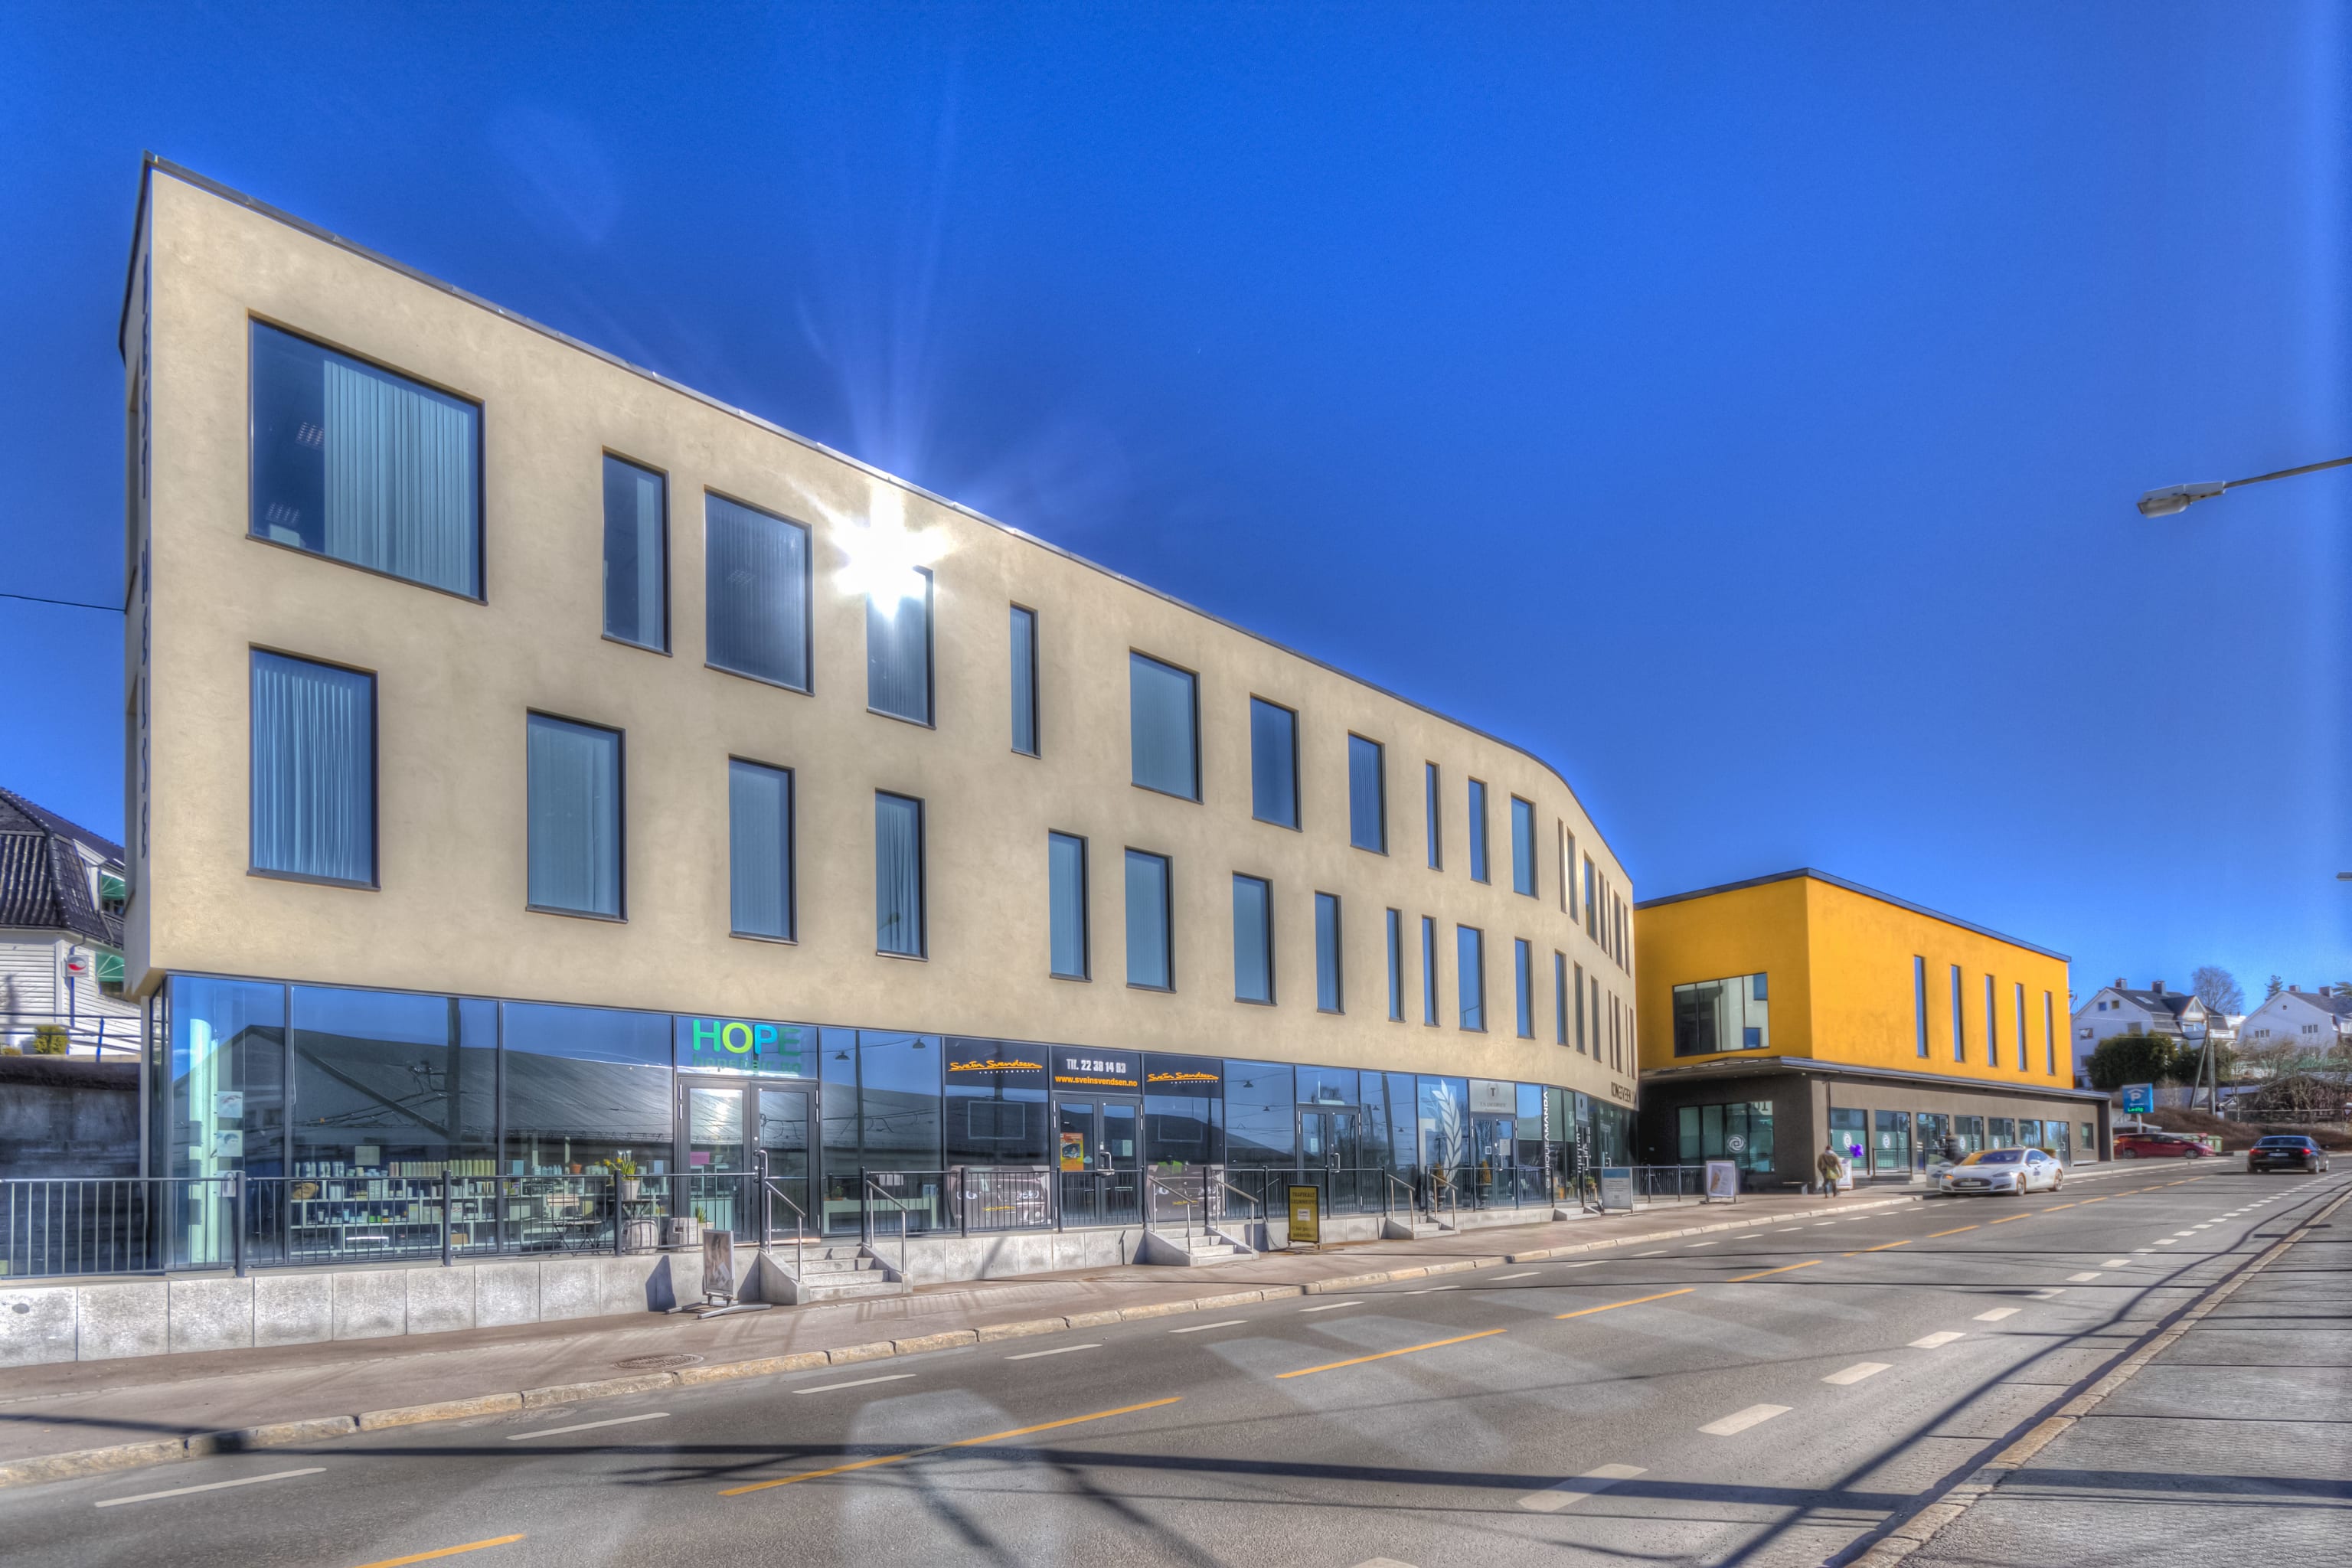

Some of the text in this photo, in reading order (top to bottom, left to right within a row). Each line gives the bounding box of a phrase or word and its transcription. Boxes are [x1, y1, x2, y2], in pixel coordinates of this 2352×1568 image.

[692, 1019, 802, 1057] HOPE
[985, 1059, 1043, 1070] Svendsen
[1080, 1060, 1092, 1071] 22
[1105, 1062, 1115, 1073] 14
[1054, 1075, 1138, 1087] www.sveinsvendsen.no
